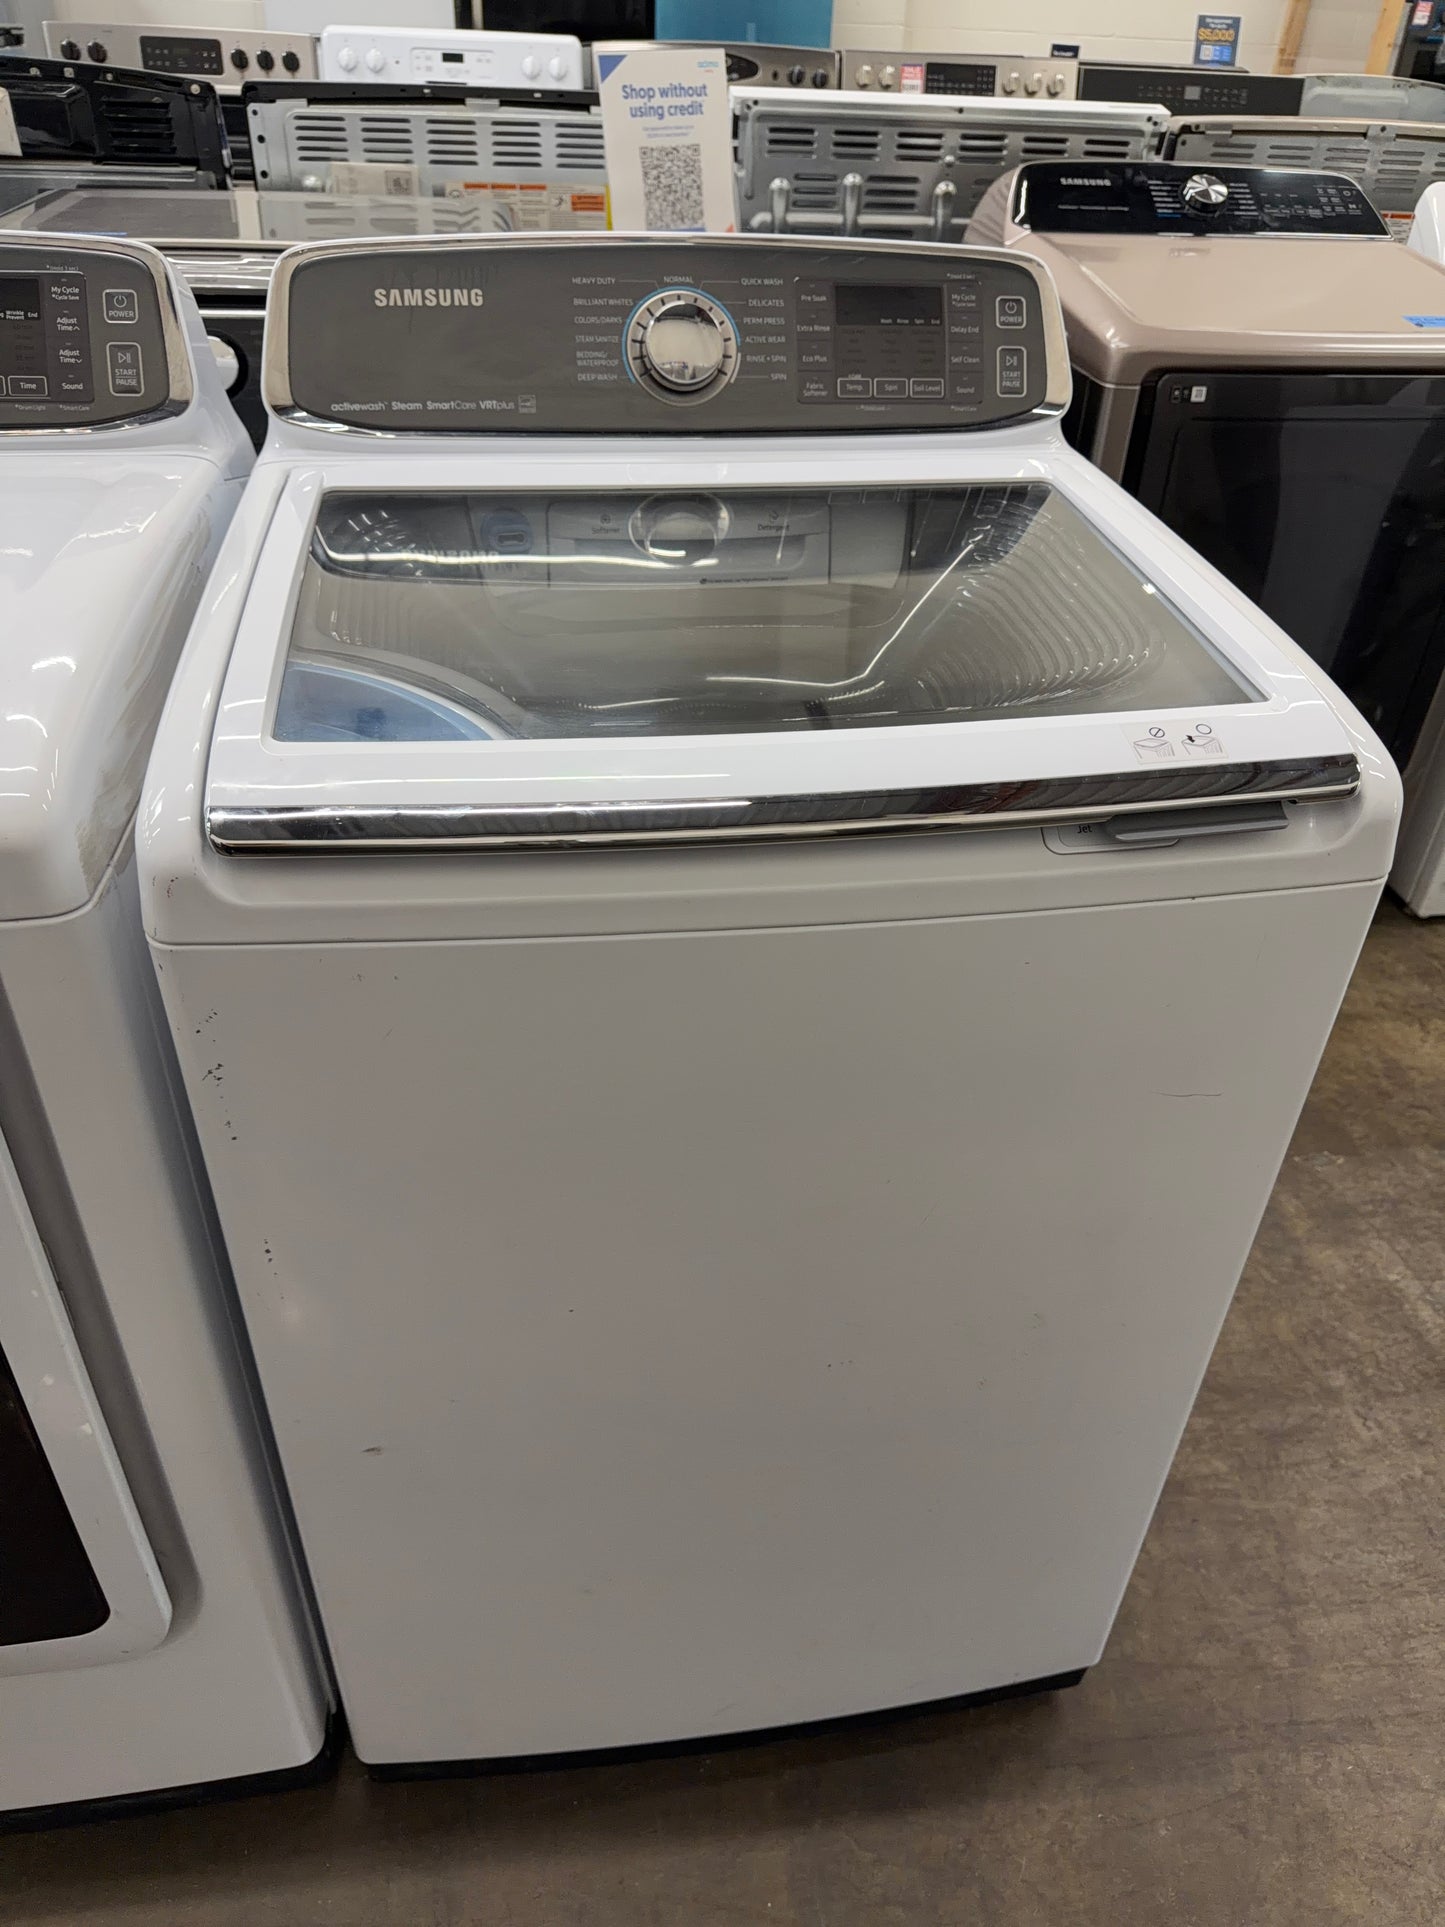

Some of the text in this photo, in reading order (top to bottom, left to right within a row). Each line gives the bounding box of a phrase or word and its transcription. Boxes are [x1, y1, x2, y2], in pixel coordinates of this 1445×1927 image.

[622, 82, 708, 102] Shop without
[630, 101, 704, 120] using credit
[1060, 177, 1112, 187] SAMSUNG
[572, 276, 616, 285] HEAVY DUTY
[664, 275, 694, 284] NORMAL
[741, 277, 784, 286] QUICK WASH
[51, 286, 80, 295] My Cycle
[374, 288, 484, 307] SAMSUNG
[573, 297, 634, 306] BRILLIANT WHITES
[801, 294, 812, 302] Pre
[748, 299, 785, 307] DELICATES
[108, 310, 135, 318] POWER
[56, 317, 78, 326] Adjust
[743, 317, 786, 325] PERM PRESS
[797, 324, 813, 332] Extra
[950, 326, 979, 335] Delay End
[745, 335, 786, 344] ACTIVE WEAR
[58, 349, 80, 358] Adjust
[59, 356, 76, 364] Time
[746, 355, 766, 363] RINSE
[771, 355, 787, 363] SPIN
[115, 368, 137, 376] START
[770, 373, 787, 381] SPIN
[19, 382, 37, 390] Time
[62, 382, 84, 390] Sound
[115, 378, 138, 386] PAUSE
[884, 384, 898, 392] Spin
[925, 384, 941, 392] Level
[331, 401, 385, 412] activewash
[391, 400, 423, 411] Steam
[426, 400, 477, 411] SmartCare
[479, 400, 515, 412] VRTplus
[757, 524, 789, 532] Detergent
[1076, 824, 1092, 834] Jet
